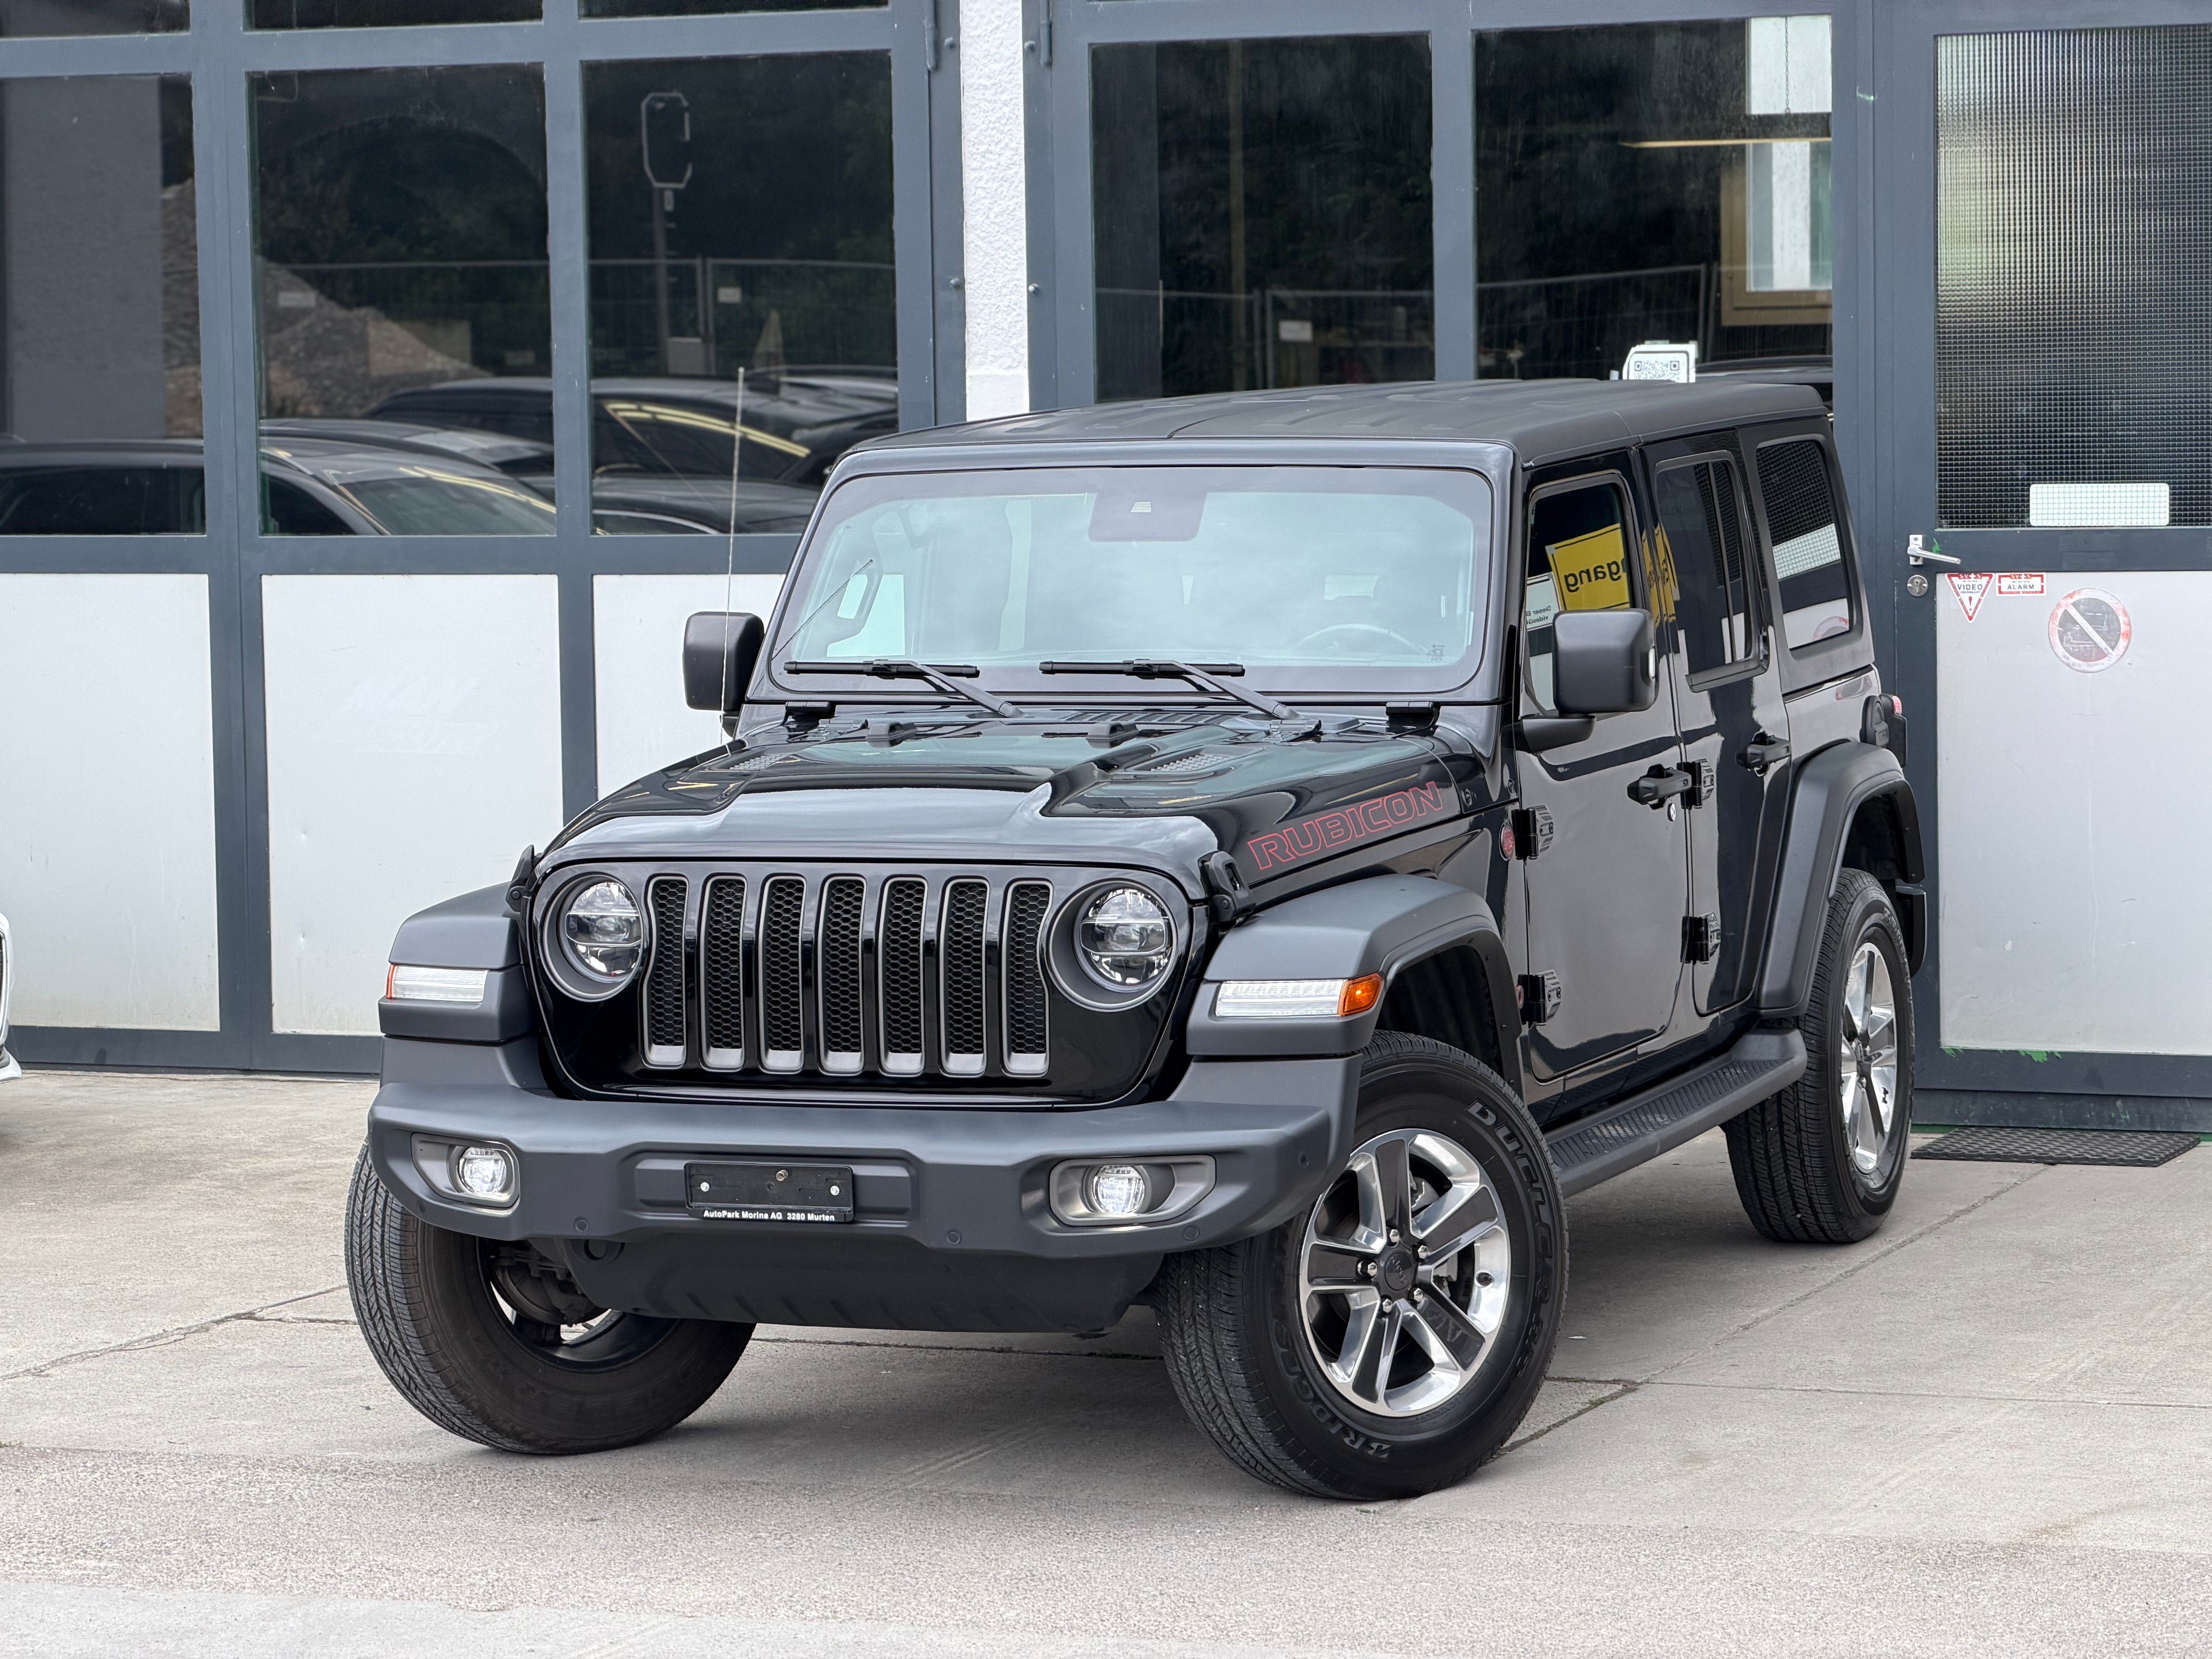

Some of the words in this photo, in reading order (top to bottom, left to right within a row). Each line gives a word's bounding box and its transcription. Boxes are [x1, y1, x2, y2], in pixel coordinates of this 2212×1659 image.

[1247, 781, 1444, 870] RUBICON
[703, 1210, 740, 1218] AutoPark
[807, 1213, 835, 1221] Murten
